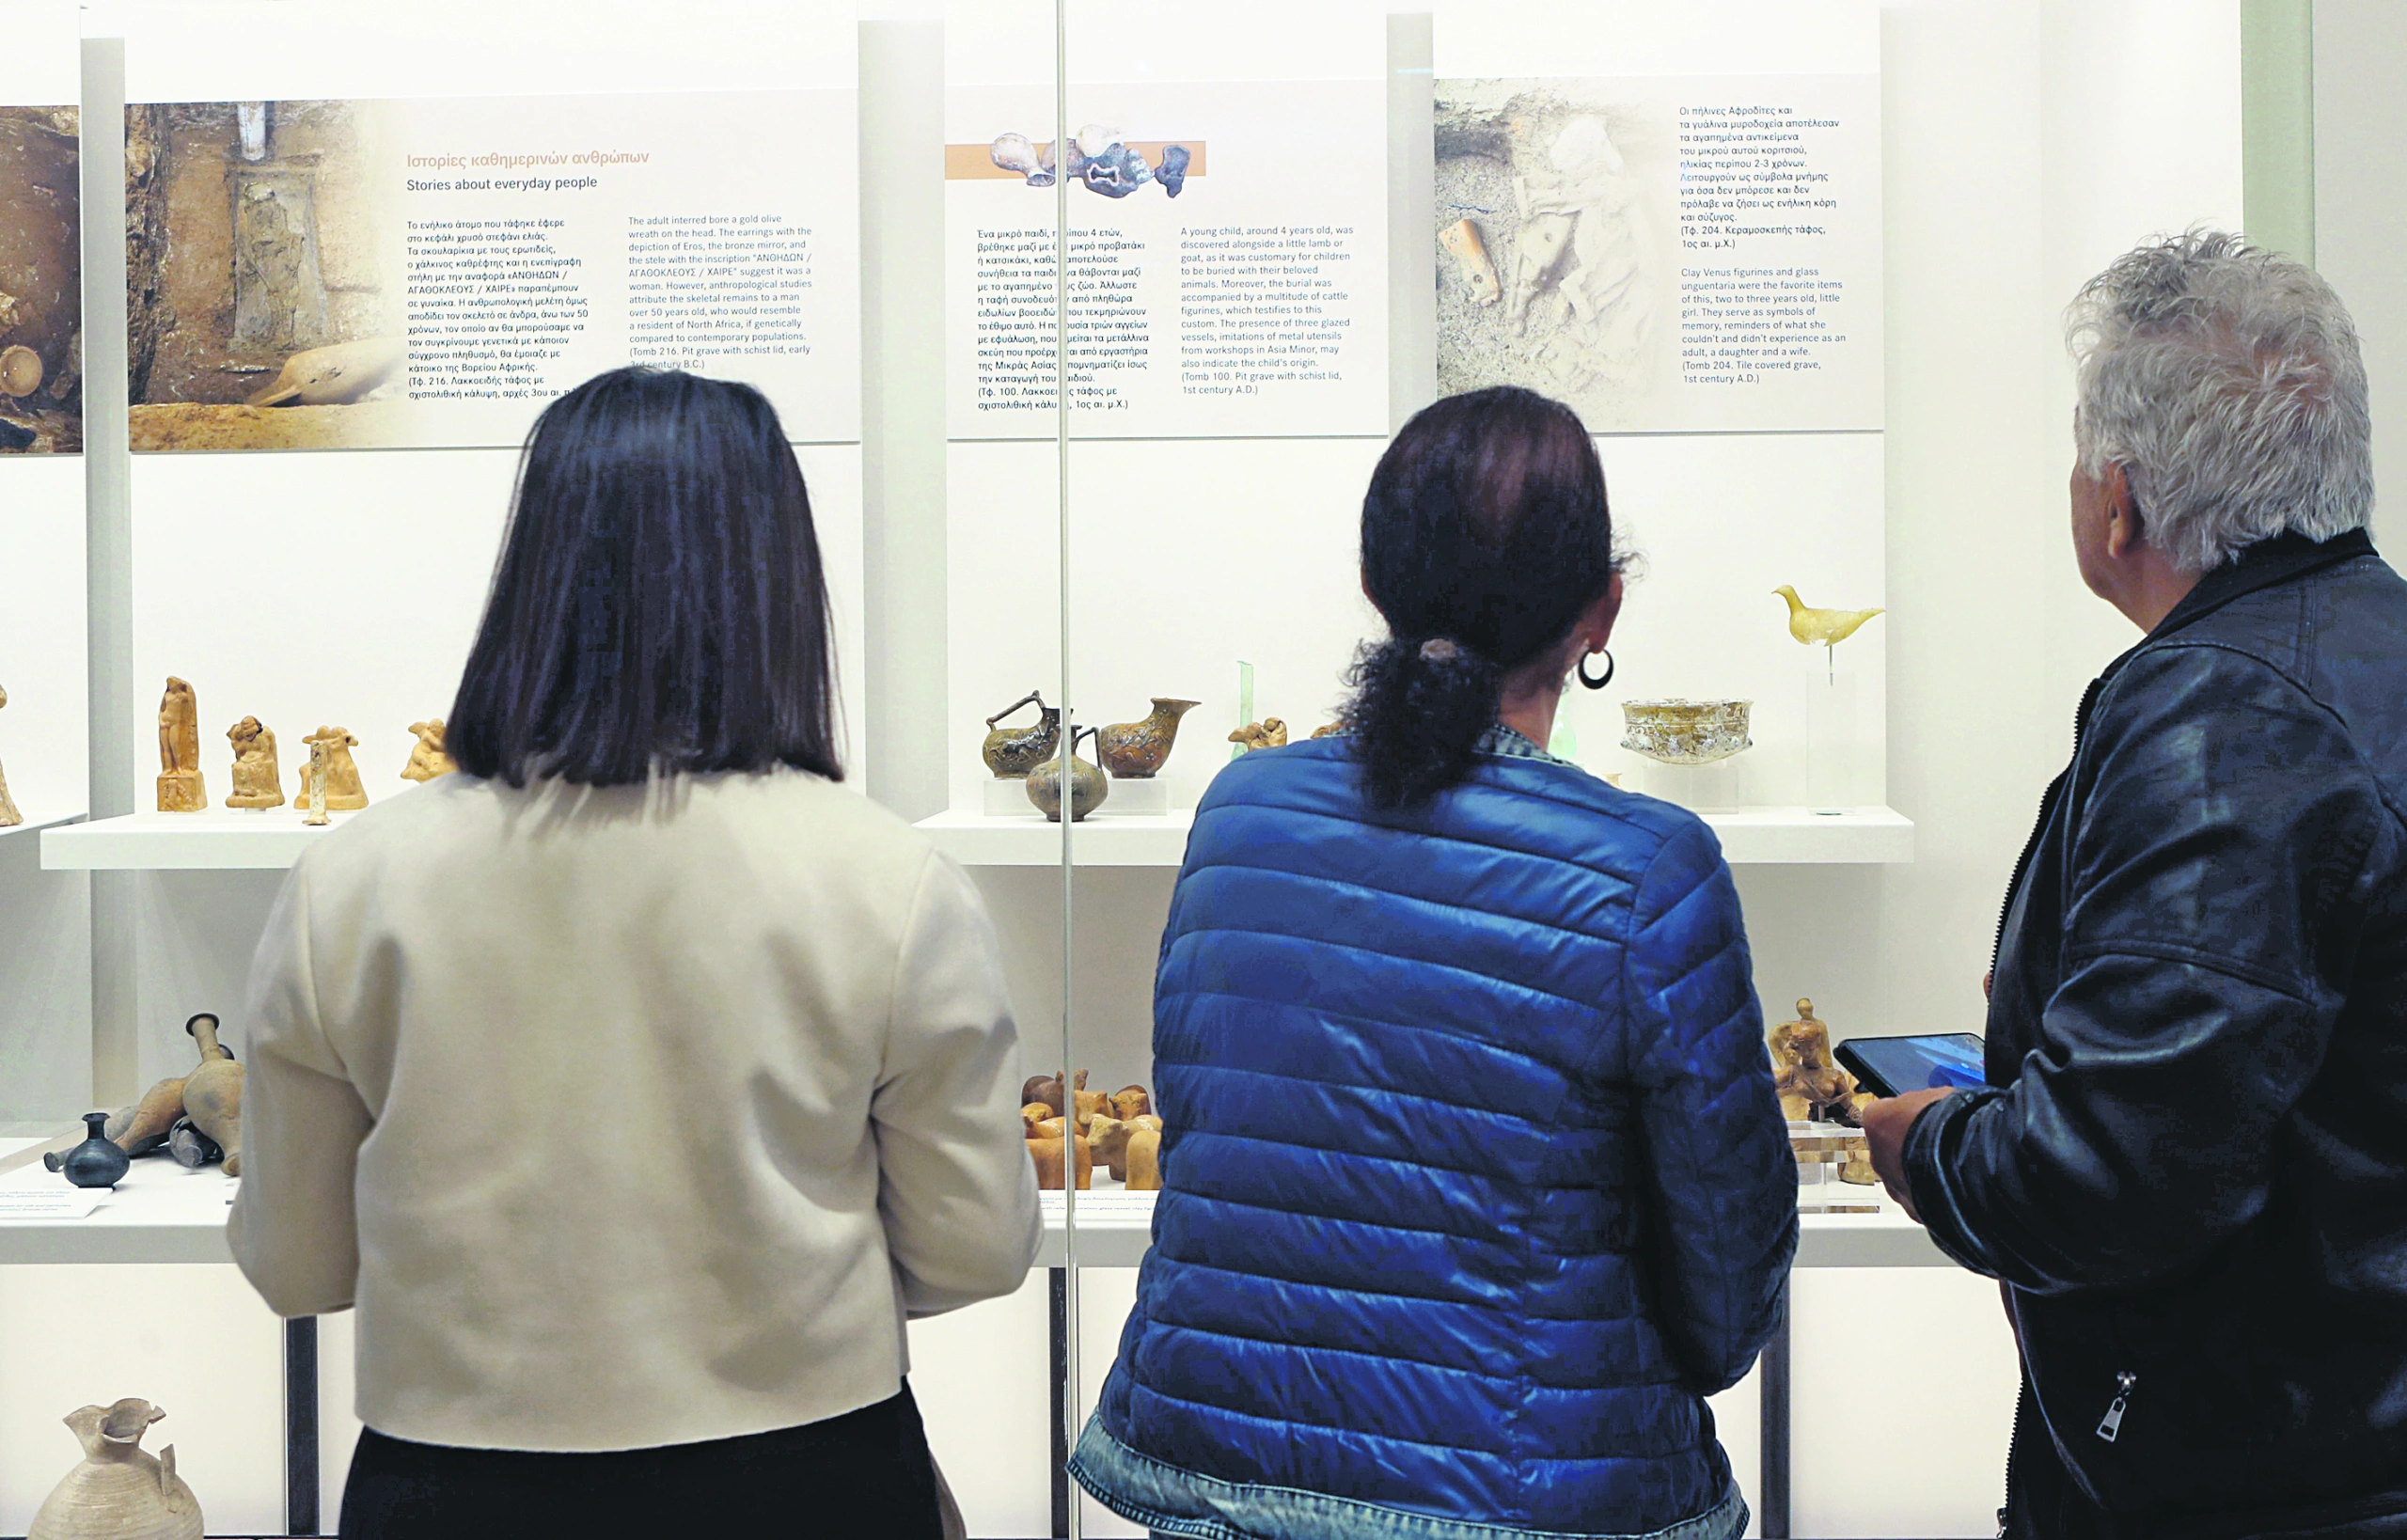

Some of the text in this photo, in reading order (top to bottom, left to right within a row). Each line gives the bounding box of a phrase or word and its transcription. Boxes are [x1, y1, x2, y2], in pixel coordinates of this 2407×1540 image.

[1679, 106, 1689, 115] Οι
[1691, 106, 1725, 117] πήλινες
[1728, 105, 1775, 116] Αφροδίτες
[1692, 119, 1727, 130] γυάλινα
[1730, 118, 1783, 130] μυροδοχεία
[1786, 118, 1839, 127] αποτέλεσαν
[1692, 133, 1743, 143] αγαπημένα
[1745, 132, 1799, 142] αντικείμενα
[1698, 146, 1728, 156] μικρού
[1761, 145, 1806, 155] κοριτσιού,
[407, 149, 649, 169] Ιστορίες καθημερινών ανθρώπων
[1680, 158, 1807, 169] ηλικίας περίπου 2-3 χρόνων.
[1680, 171, 1828, 182] Λειτουργούν ως σύμβολα μνήμης
[406, 175, 597, 192] Stories about everyday people
[407, 220, 417, 229] Το
[419, 220, 453, 231] ενήλικο
[455, 219, 481, 230] άτομο
[503, 218, 535, 229] τάφηκε
[538, 218, 564, 228] έφερε
[628, 216, 644, 225] The
[647, 215, 669, 225] adult
[671, 215, 706, 225] interred
[709, 214, 729, 224] bore
[739, 214, 758, 225] gold
[761, 213, 781, 223] olive
[424, 233, 454, 244] κεφάλι
[456, 232, 483, 244] χρυσό
[485, 231, 519, 243] στεφάνι
[522, 231, 547, 242] ελιάς.
[1180, 227, 1187, 235] A
[1189, 228, 1217, 237] young
[1219, 226, 1243, 236] child,
[1246, 226, 1278, 235] around
[1281, 226, 1286, 234] 4
[1289, 228, 1314, 236] years
[1315, 226, 1332, 235] old,
[407, 244, 556, 257] Τα σκουλαρίκια με τους ερωτιδείς,
[628, 240, 806, 253] depiction of Eros, the bronze mirror, and
[1180, 240, 1229, 248] discovered
[1232, 239, 1275, 250] alongside
[1285, 239, 1306, 247] little
[1309, 239, 1330, 247] lamb
[415, 259, 452, 270] χάλκινος
[456, 258, 503, 269] καθρέφτης
[530, 257, 581, 268] ενεπίγραφη
[977, 256, 983, 266] ή
[985, 255, 1031, 265] κατσικάκι,
[1033, 255, 1056, 263] καθώ
[977, 268, 1018, 279] συνήθεια
[1033, 268, 1056, 276] παιδι
[1078, 267, 1119, 278] θάβονται
[1122, 266, 1141, 277] μαζί
[1681, 267, 1818, 278] Clay Venus figurines and glass
[407, 284, 474, 294] ΑΓΑΘΟΚΛΕΟΥΣ
[485, 284, 515, 293] ΧΑΙΡΕ»
[518, 283, 578, 294] παραπέμπουν
[666, 280, 706, 291] However,
[709, 279, 777, 291] anthropological
[779, 279, 811, 288] studies
[1681, 281, 1735, 291] unguentaria
[1763, 280, 1777, 289] the
[1780, 280, 1815, 289] favorite
[1817, 280, 1842, 289] items
[1181, 305, 1322, 317] figurines, which testifies to this
[1681, 307, 1698, 319] girl.
[1701, 307, 1723, 318] They
[1766, 306, 1803, 318] symbols
[1805, 306, 1816, 315] of
[629, 331, 806, 344] compared to contemporary populations.
[1681, 334, 1719, 343] couldn't
[1721, 334, 1738, 342] and
[1740, 334, 1767, 342] didn't
[1769, 333, 1818, 344] experience
[408, 361, 537, 374] κάτοικο της Βορείου Αφρικής.
[978, 358, 1147, 371] της Μικράς Ασίας πομνηματίζει ίσως
[1181, 357, 1318, 369] also indicate the child's origin.
[1682, 360, 1820, 371] (Tomb 204. Tile covered grave,
[978, 400, 1032, 411] σχιστολιθική
[1076, 400, 1091, 410] 1ος
[1108, 399, 1127, 410] μ.Χ.)
